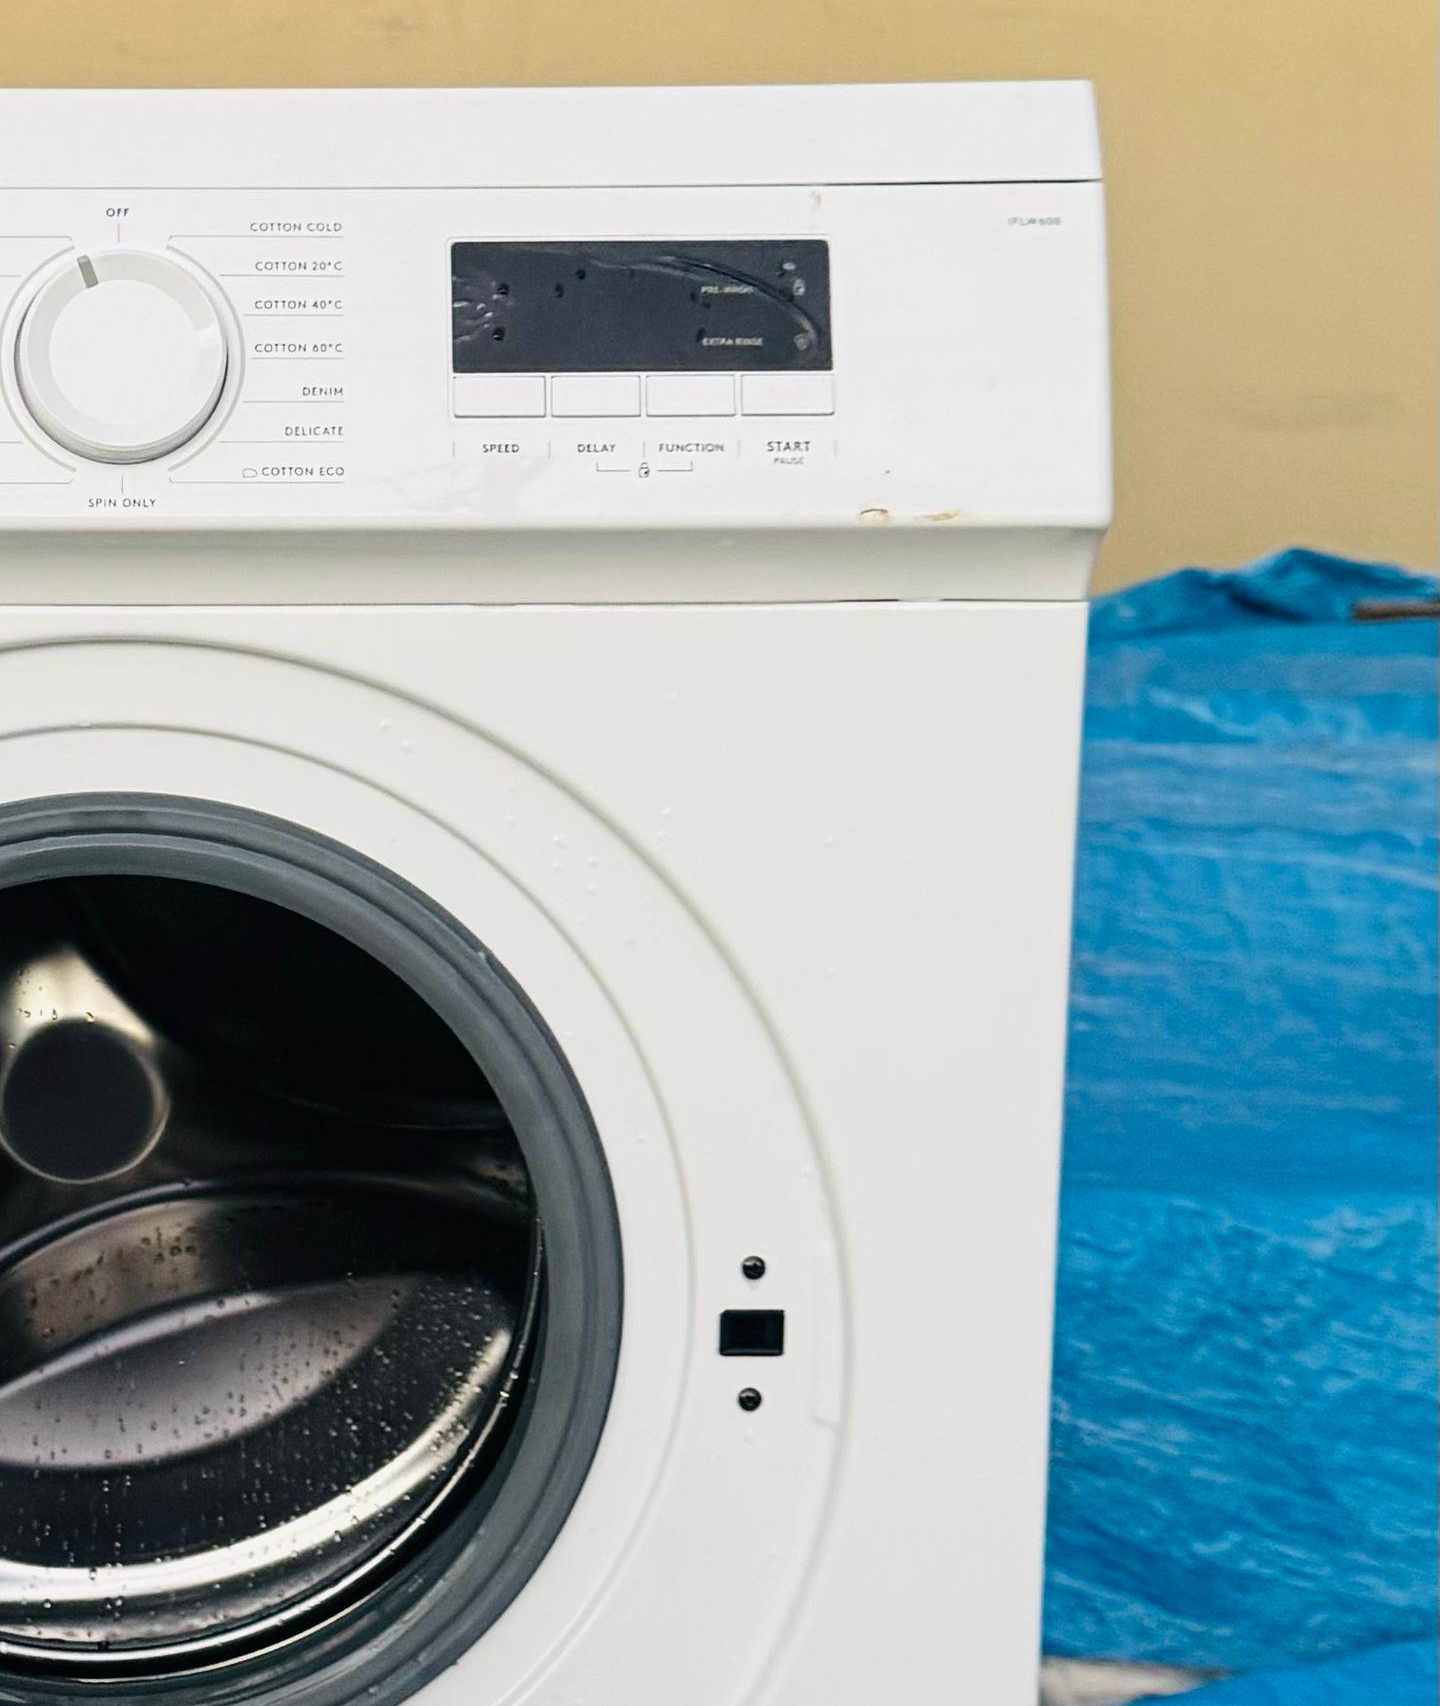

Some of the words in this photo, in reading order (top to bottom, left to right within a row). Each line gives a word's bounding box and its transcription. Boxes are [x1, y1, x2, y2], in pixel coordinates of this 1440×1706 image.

[106, 208, 130, 219] OFF
[249, 222, 302, 232] COTTON
[306, 222, 343, 232] COLD
[254, 261, 307, 271] COTTON
[311, 261, 343, 271] 20°C
[254, 300, 307, 310] COTTON
[311, 300, 344, 310] 40°C
[254, 343, 307, 353] COTTON
[311, 343, 344, 353] 60°C
[302, 386, 344, 397] DENIM
[284, 426, 344, 437] DELICATE
[482, 442, 520, 454] SPEED
[577, 442, 616, 454] DELAY
[658, 442, 725, 454] FUNCTION
[766, 440, 811, 454] START
[773, 456, 804, 466] PAUSE
[261, 466, 314, 477] COTTON
[318, 466, 345, 477] ECO
[87, 498, 117, 509] SPIN
[121, 497, 156, 508] ONLY
